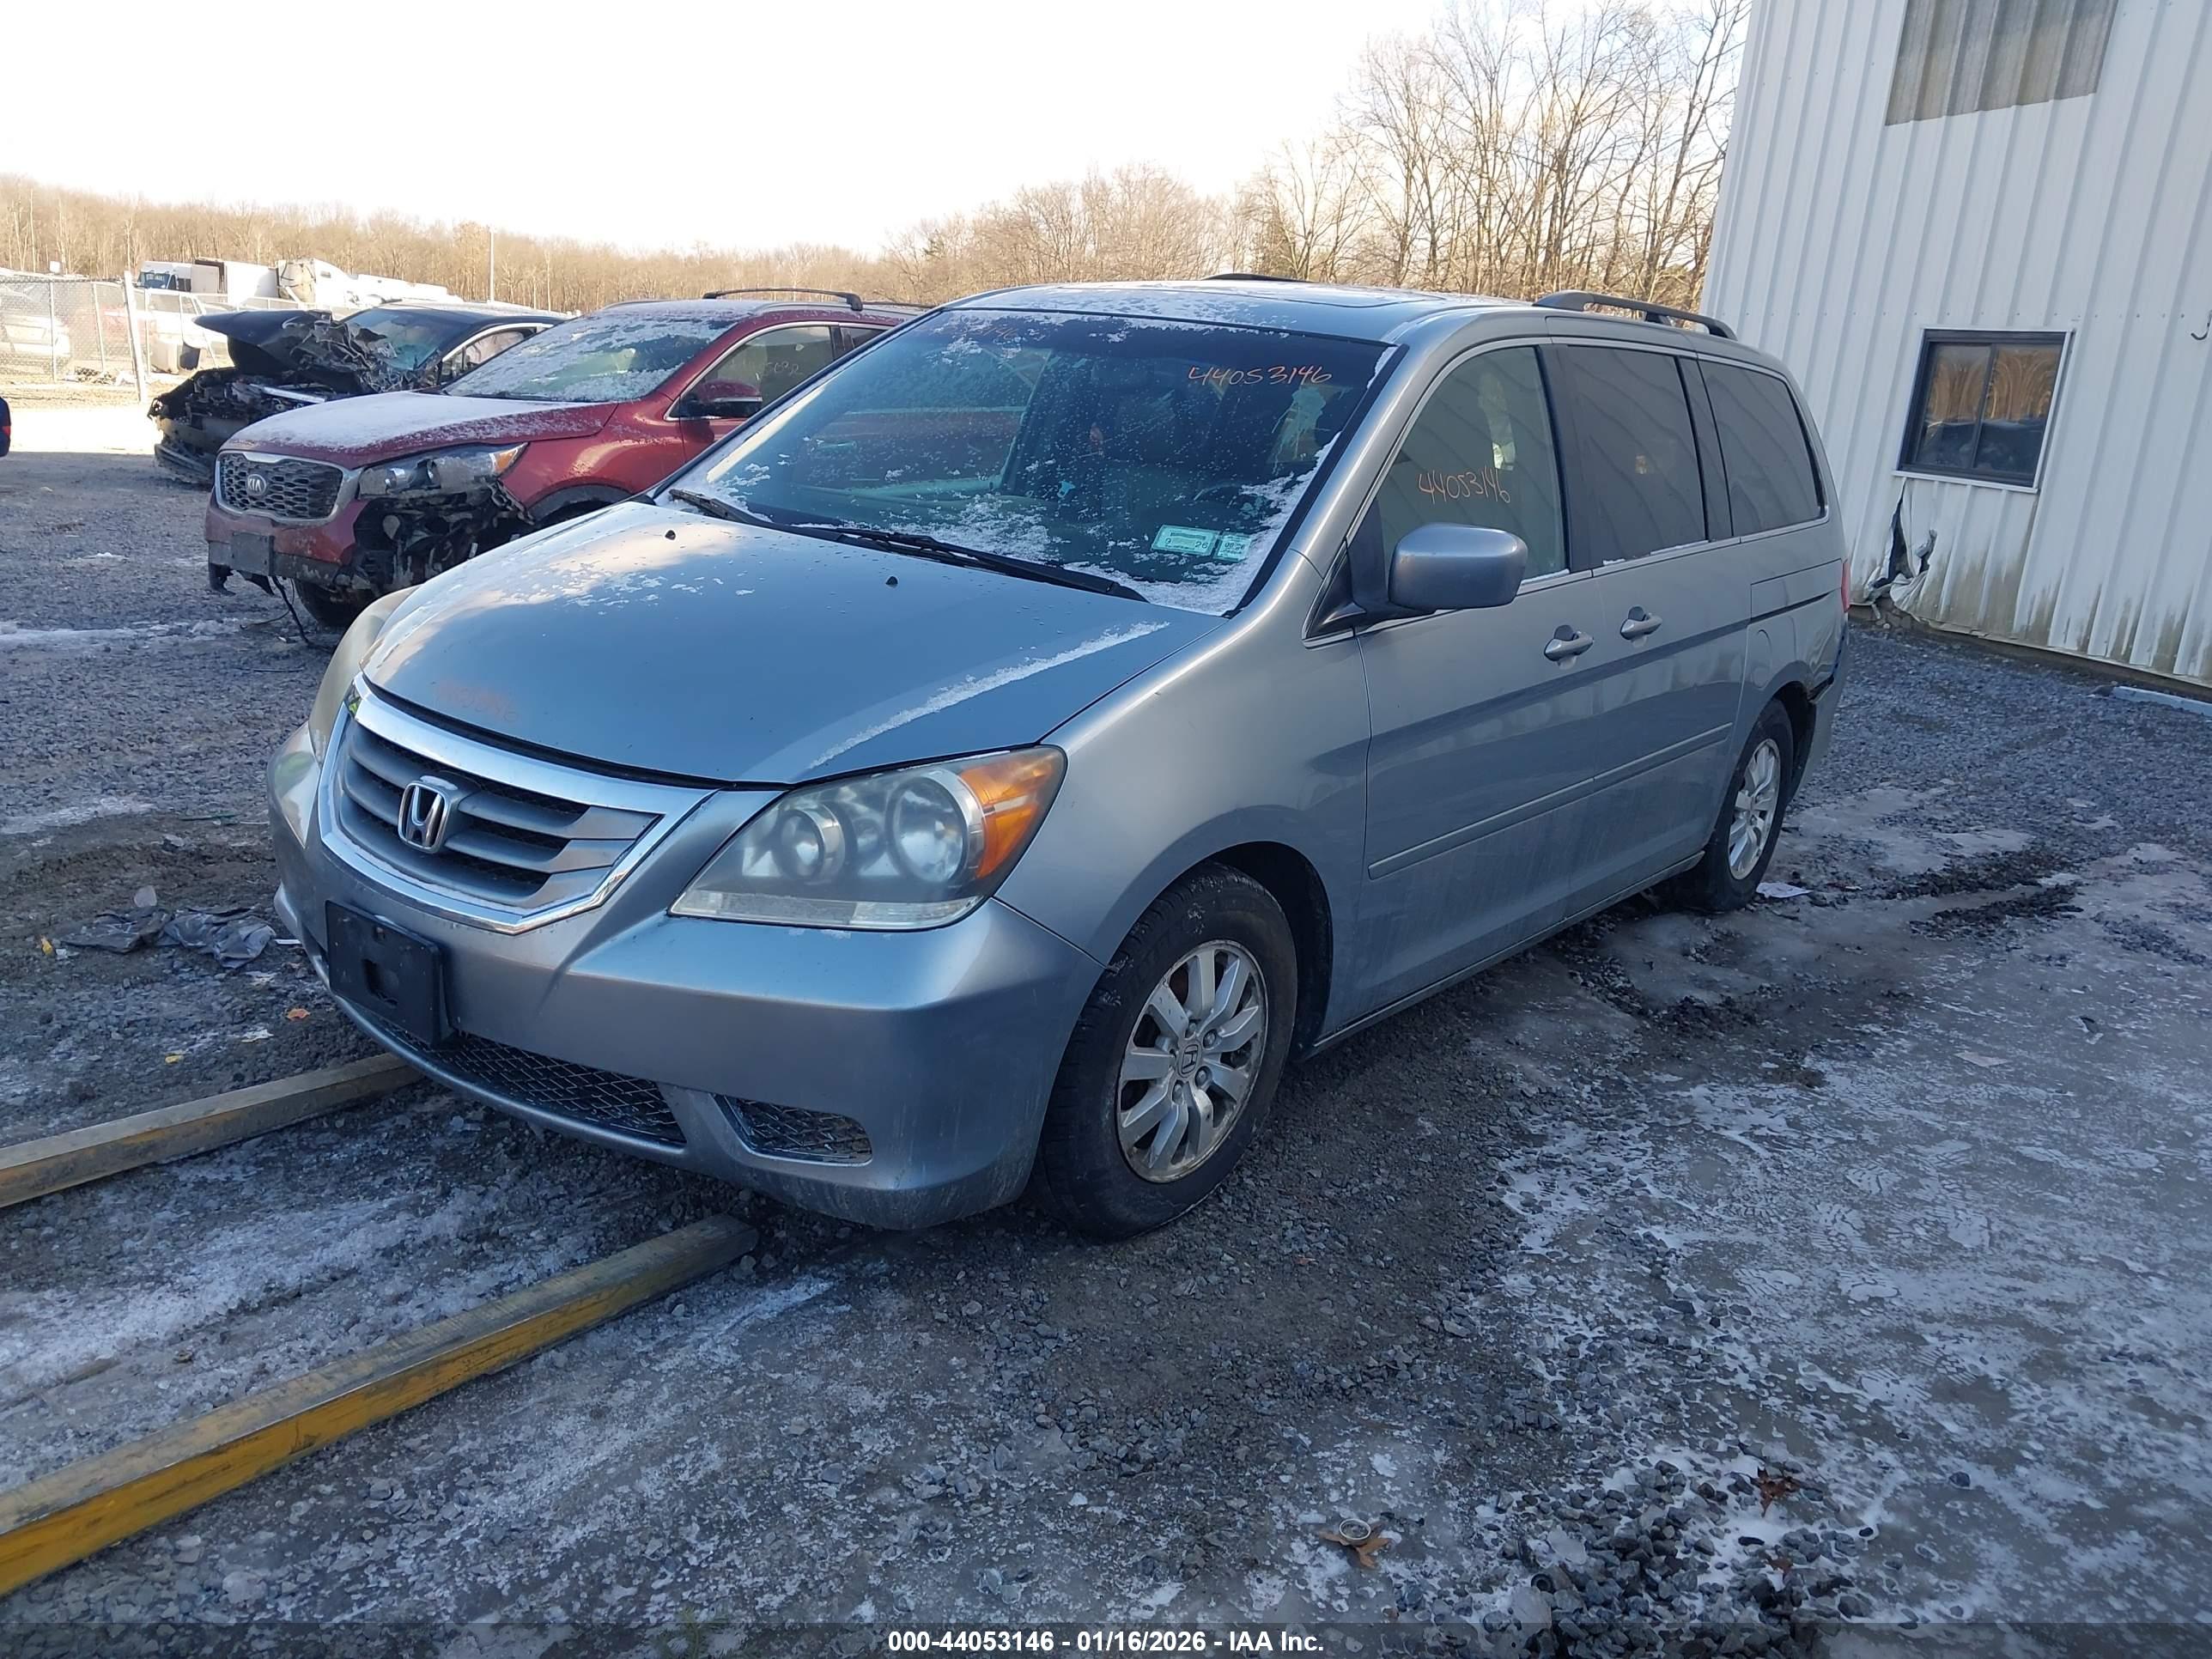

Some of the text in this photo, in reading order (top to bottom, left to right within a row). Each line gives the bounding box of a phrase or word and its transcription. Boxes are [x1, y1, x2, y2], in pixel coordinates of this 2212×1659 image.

[1188, 365, 1333, 386] 44053146
[248, 477, 263, 492] KIA
[1417, 465, 1510, 505] 44053146
[1194, 541, 1209, 550] 26
